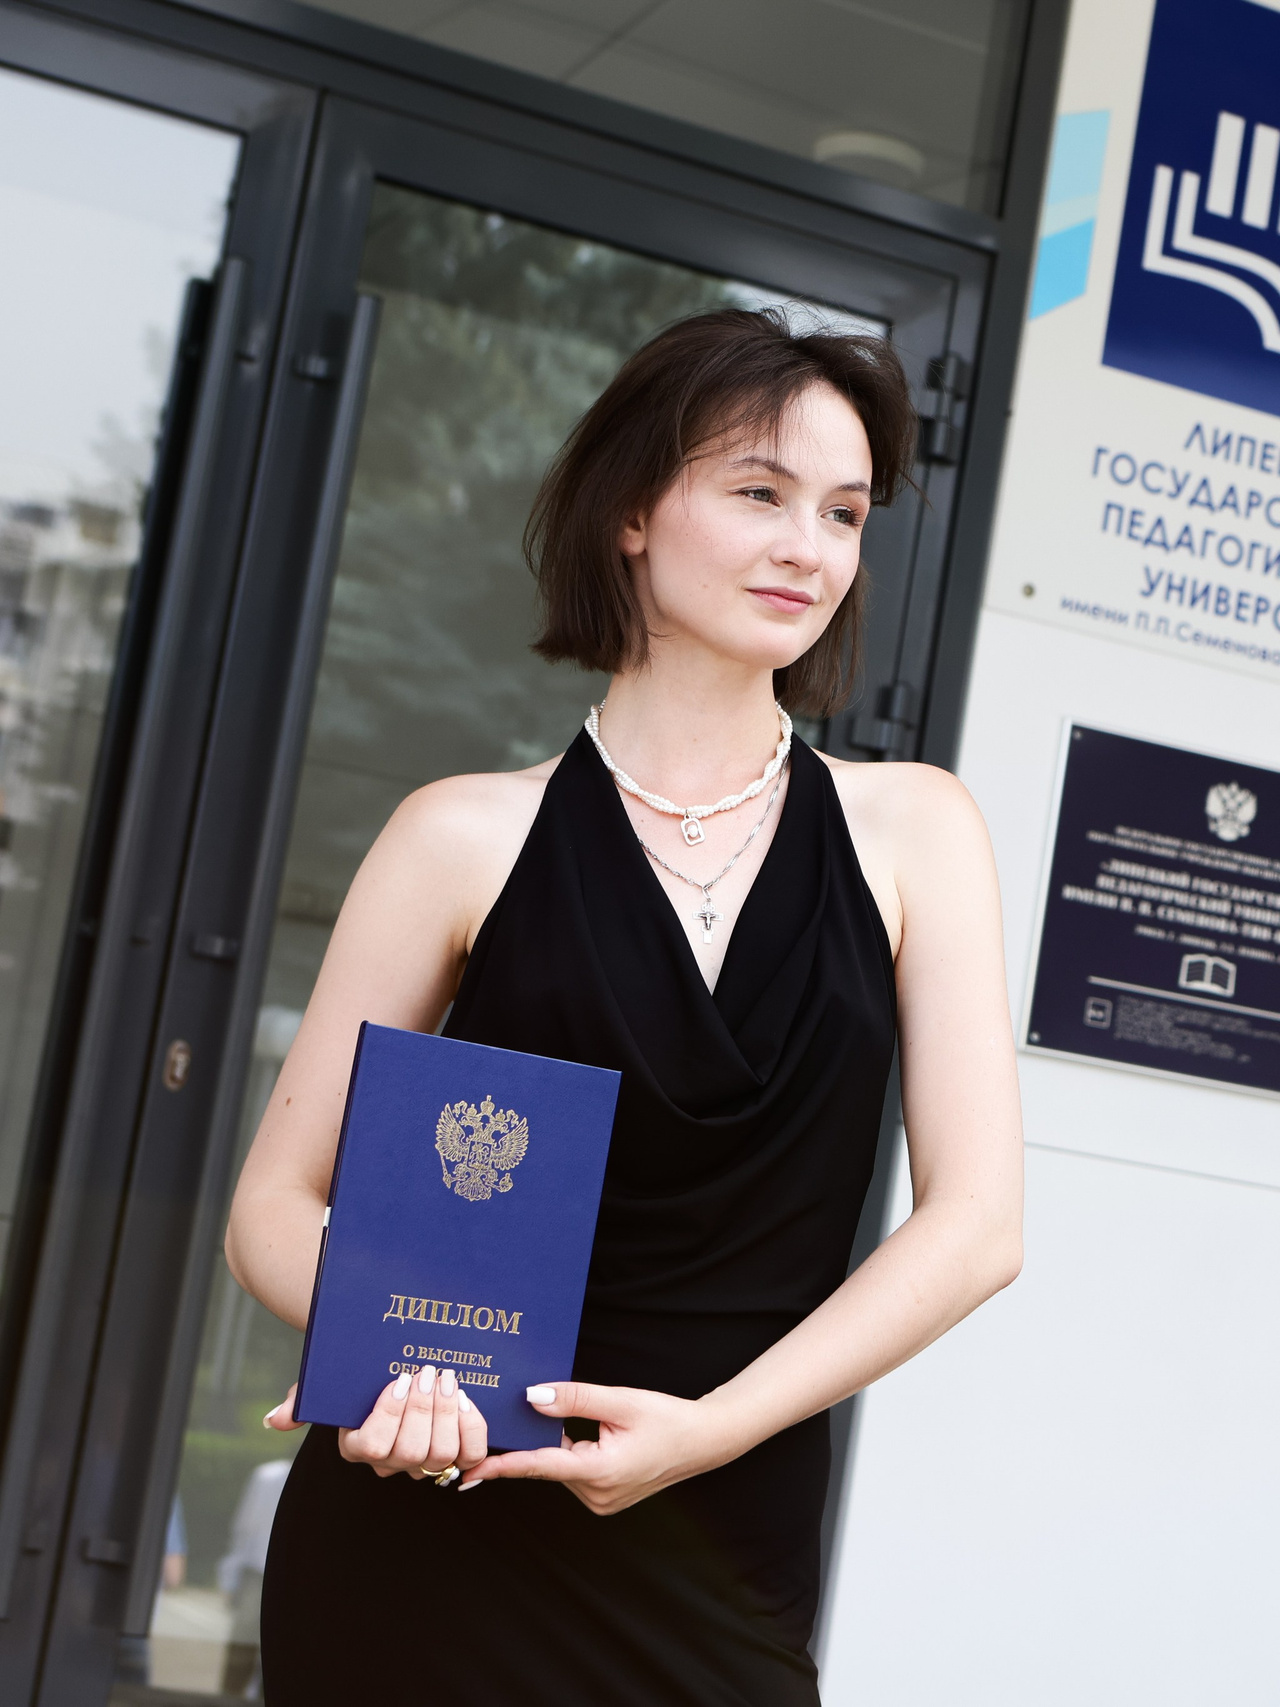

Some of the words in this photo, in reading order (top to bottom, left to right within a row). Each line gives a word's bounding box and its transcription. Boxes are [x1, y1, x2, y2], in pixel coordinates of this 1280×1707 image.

[1061, 596, 1129, 626] имени
[383, 1294, 523, 1335] ДИПЛОМ
[402, 1344, 414, 1358] О
[417, 1346, 492, 1368] ВЫСШЕМ
[388, 1361, 500, 1388] ОБРАНИИ
